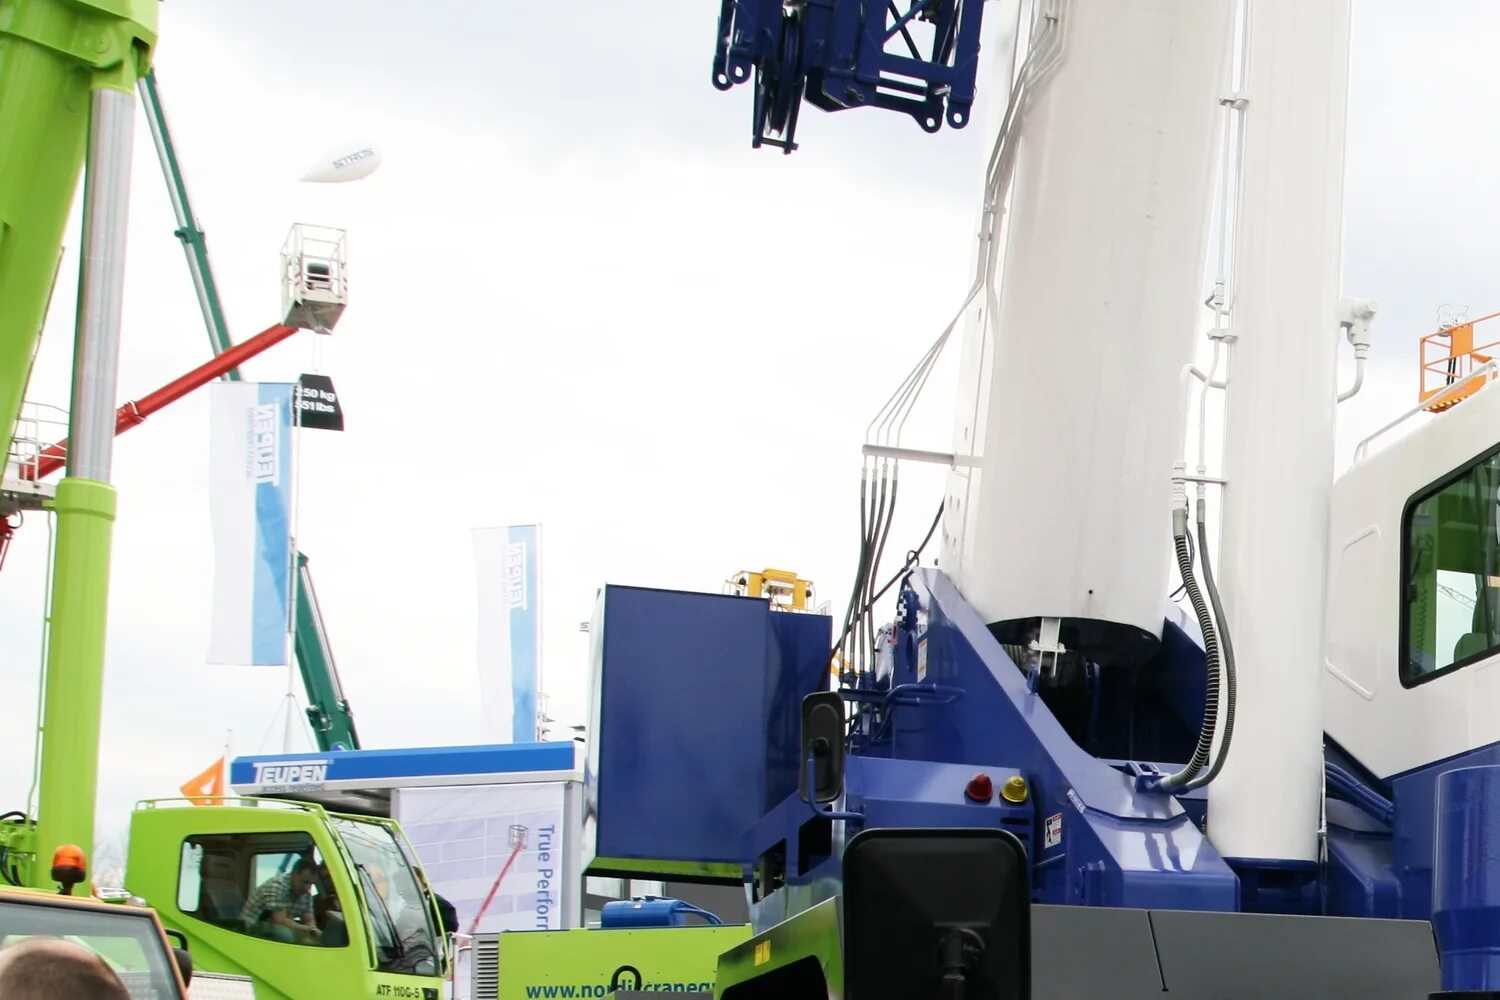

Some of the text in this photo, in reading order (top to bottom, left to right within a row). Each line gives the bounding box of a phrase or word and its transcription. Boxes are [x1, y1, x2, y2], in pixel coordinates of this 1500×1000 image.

[320, 390, 335, 403] kg
[252, 759, 329, 786] TEUPEN
[538, 824, 555, 862] True
[376, 984, 392, 997] ATF
